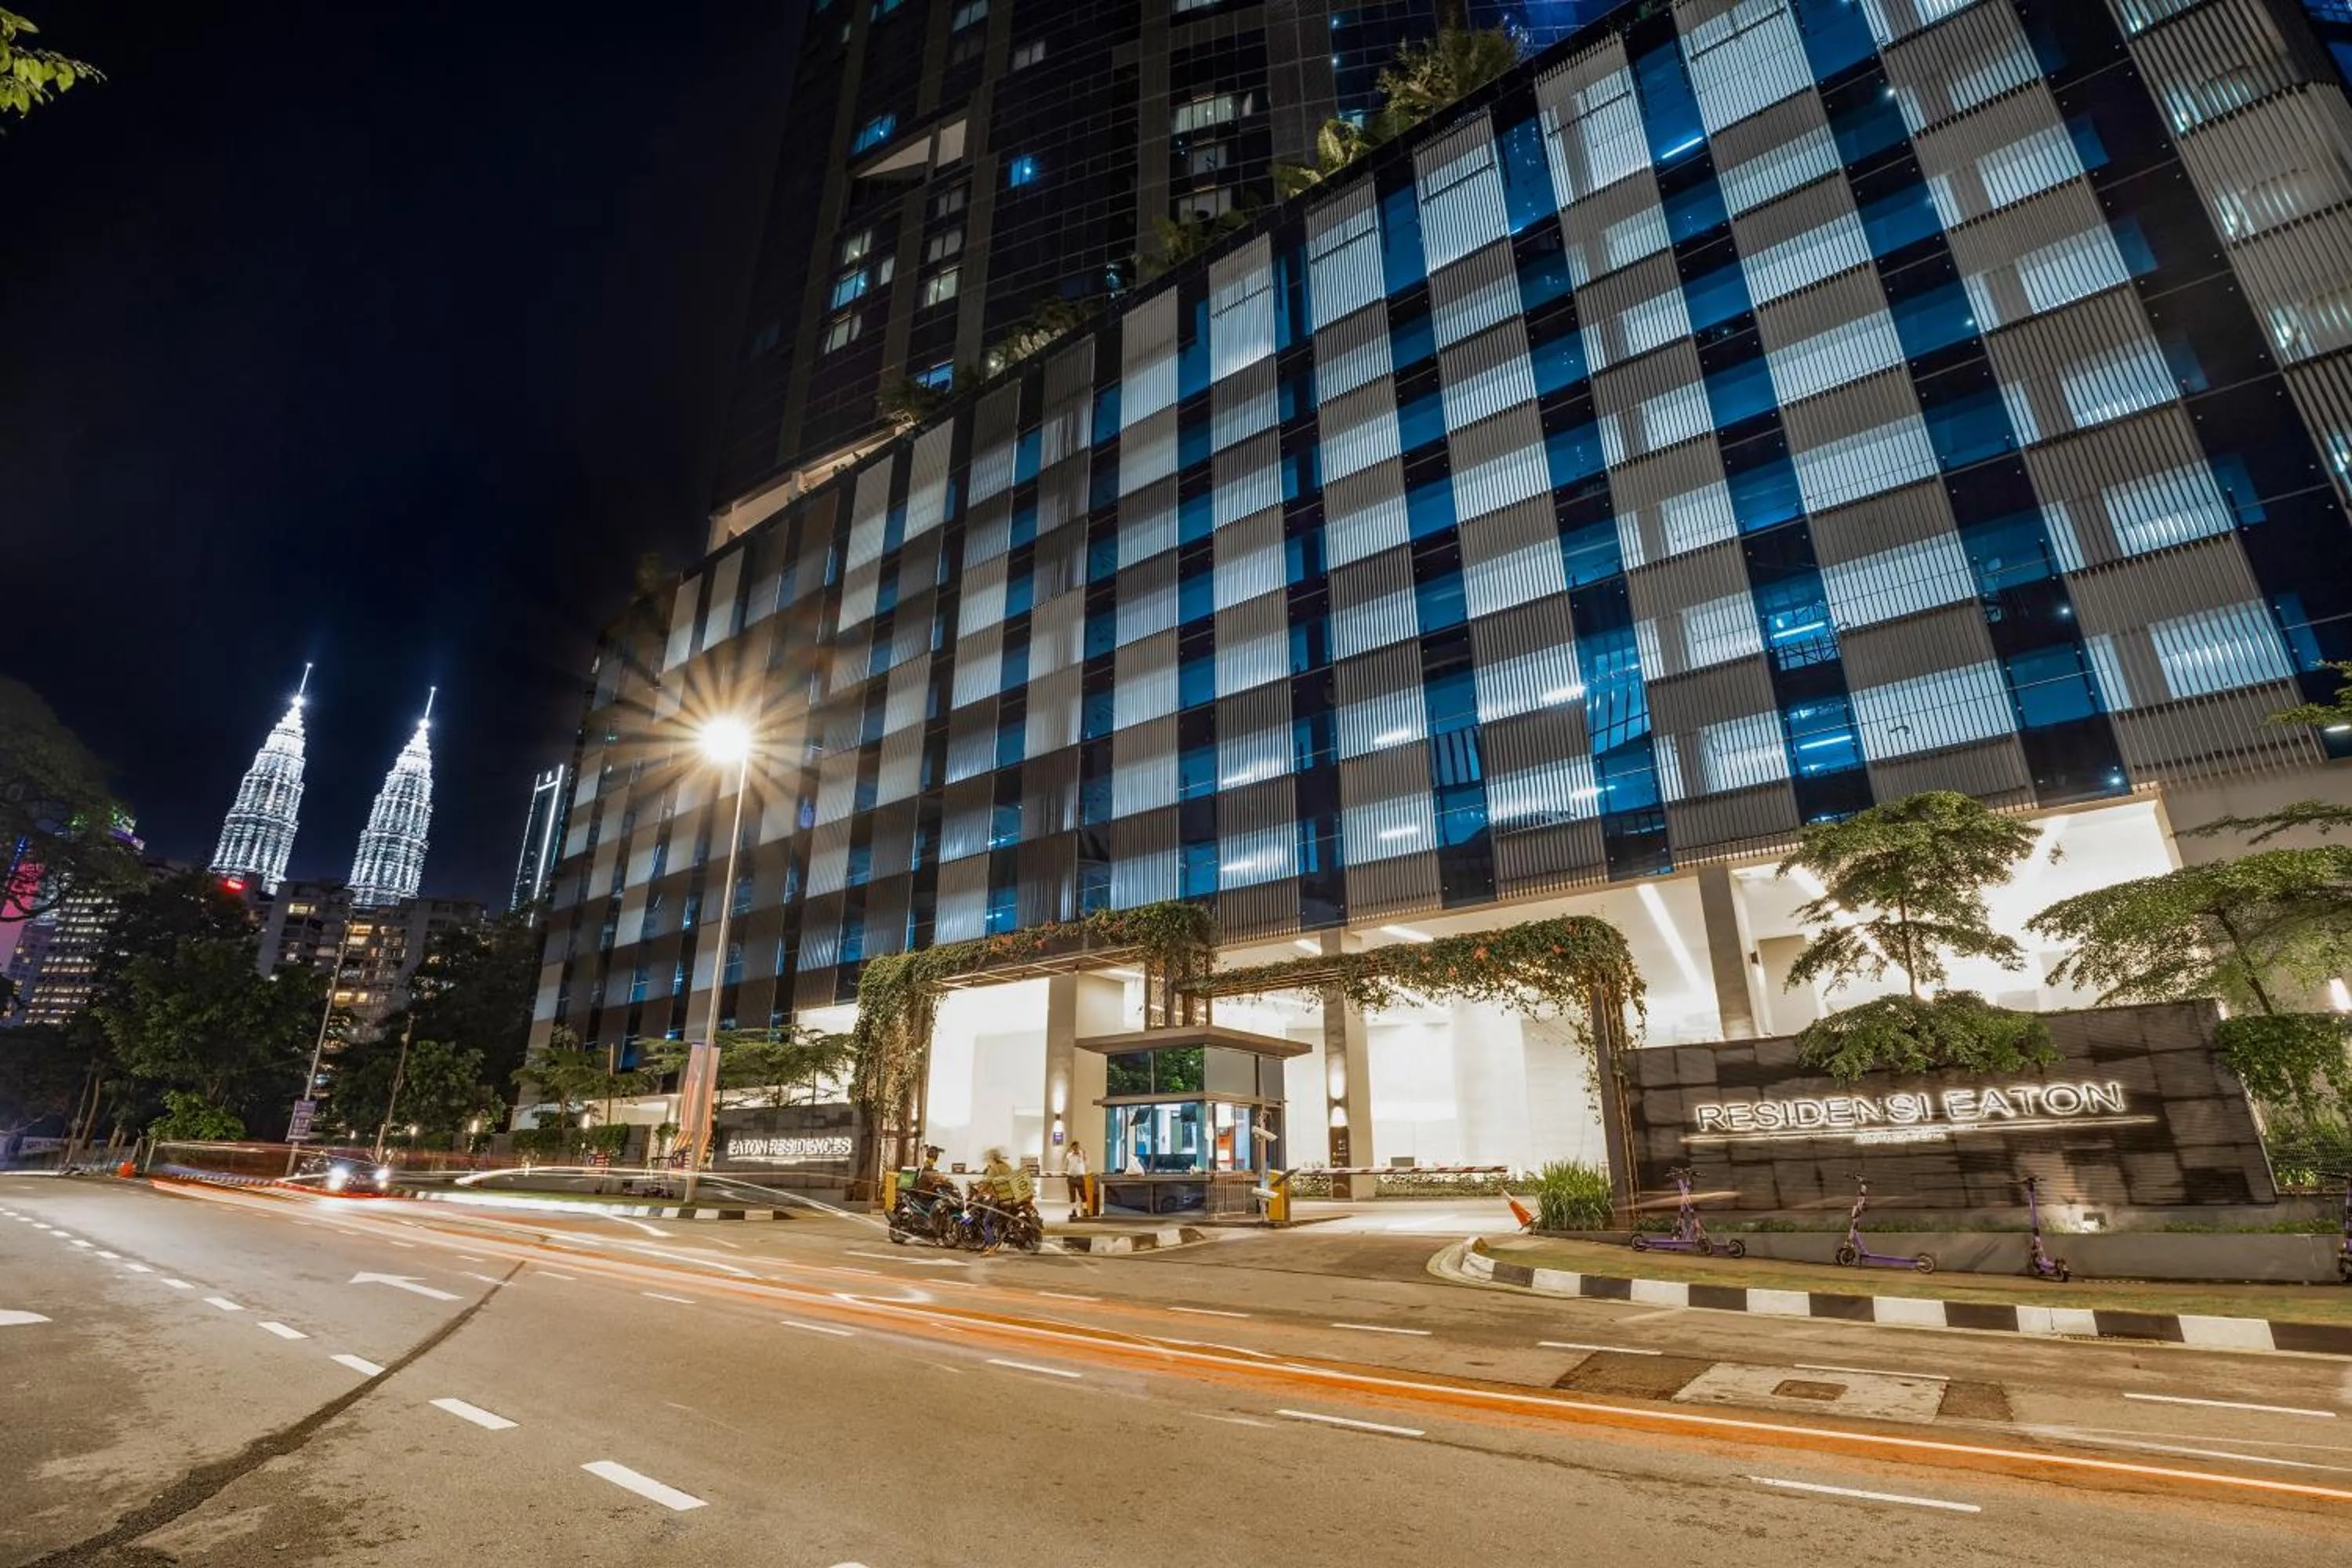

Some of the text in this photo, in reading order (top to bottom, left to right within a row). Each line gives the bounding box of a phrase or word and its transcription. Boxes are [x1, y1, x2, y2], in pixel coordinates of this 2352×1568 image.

[1697, 1081, 2126, 1131] RESIDENSI EATON
[728, 1137, 852, 1156] EATON RESIDENCES
